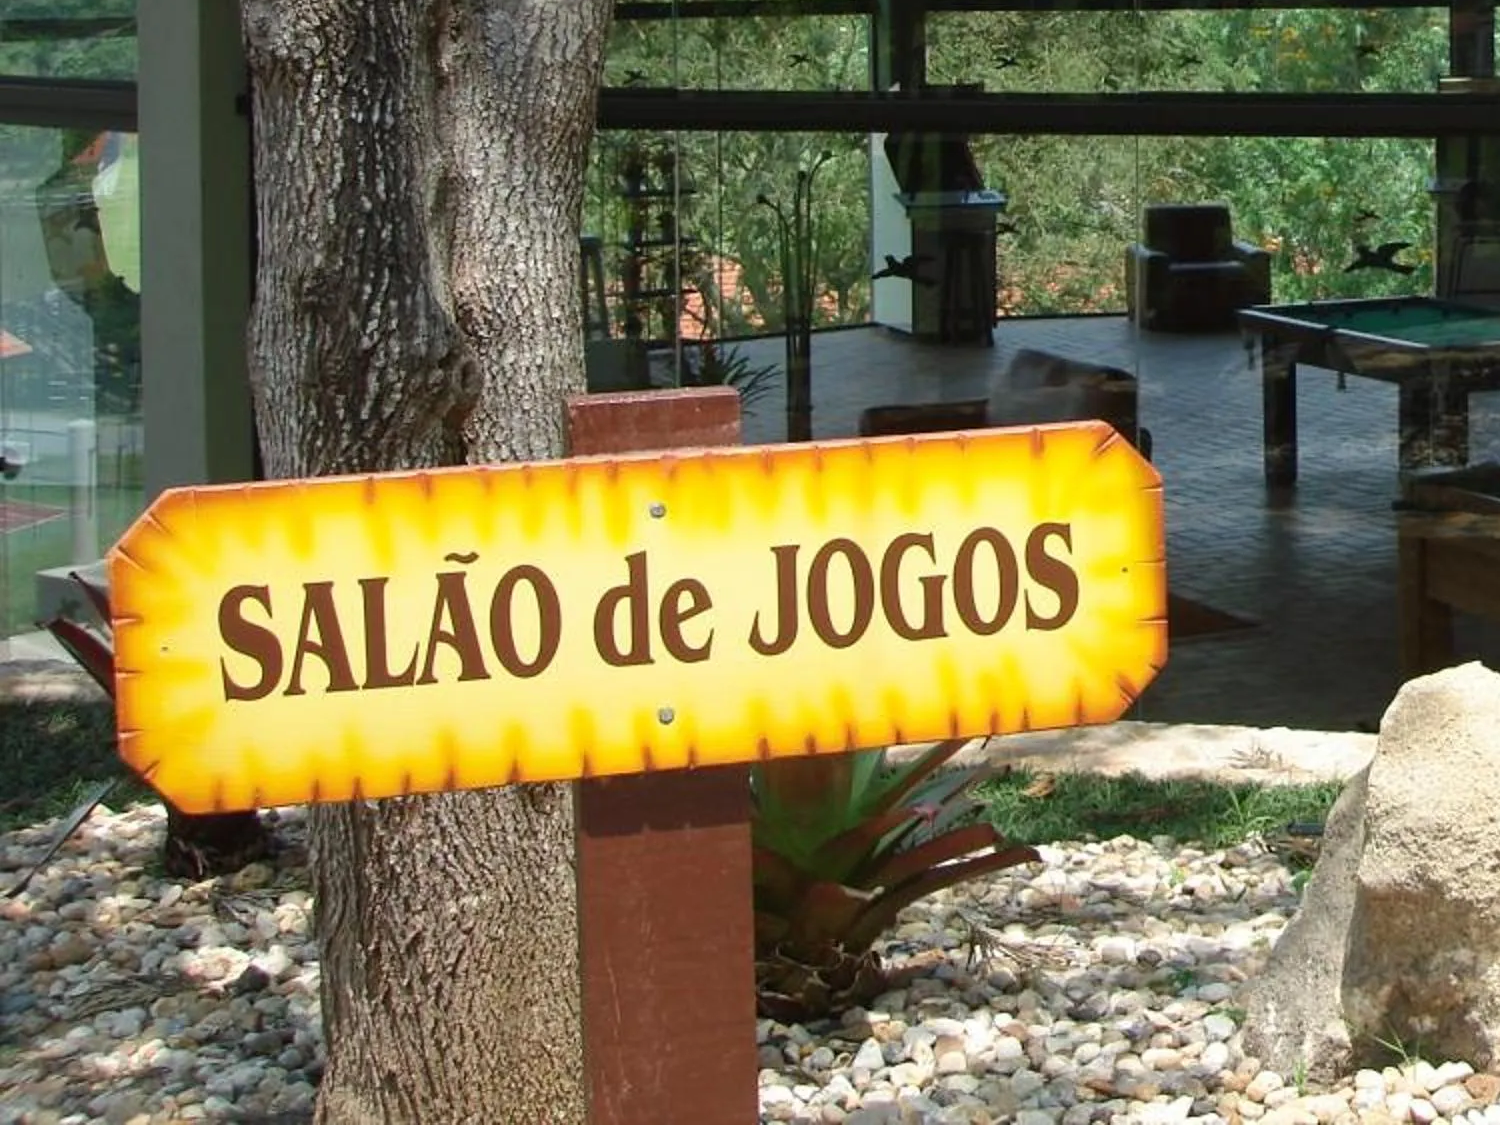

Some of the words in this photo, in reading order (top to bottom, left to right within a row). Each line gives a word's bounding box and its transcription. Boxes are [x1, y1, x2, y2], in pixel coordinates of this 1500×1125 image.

[218, 553, 561, 702] SALÃO
[593, 551, 714, 667] de
[748, 522, 1080, 656] JOGOS
